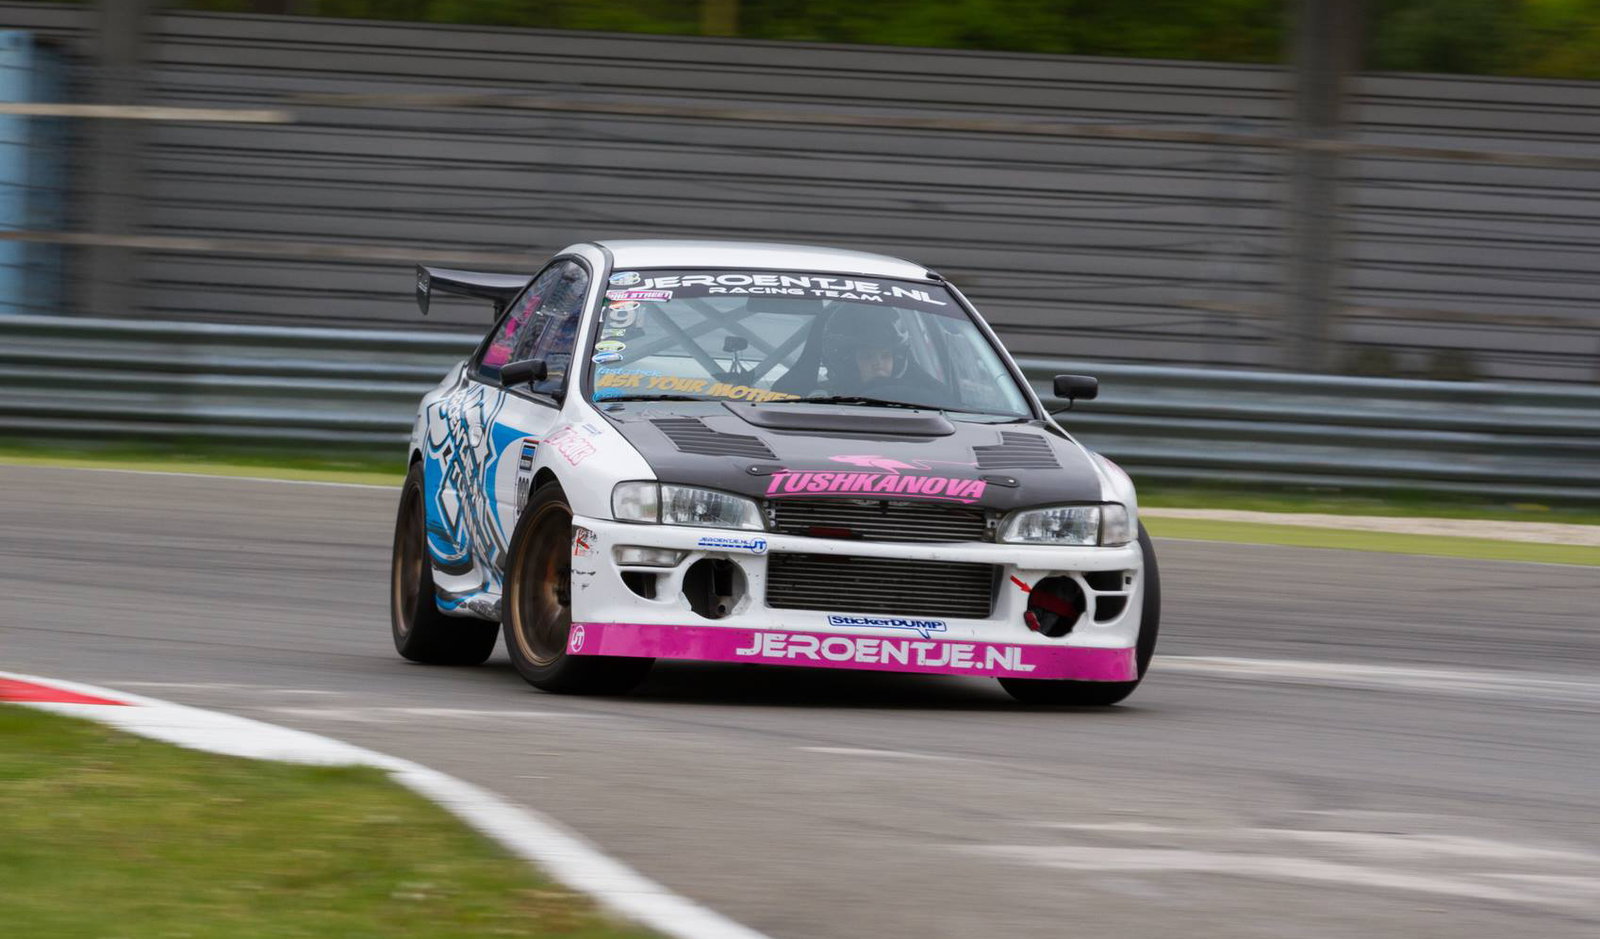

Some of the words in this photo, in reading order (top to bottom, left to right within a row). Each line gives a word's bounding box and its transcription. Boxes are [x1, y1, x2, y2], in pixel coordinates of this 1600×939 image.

[628, 274, 946, 305] JEROENTJE.NL
[708, 286, 797, 296] RACING
[802, 287, 883, 302] TEAM
[597, 374, 643, 388] ASK
[646, 376, 706, 393] YOUR
[765, 472, 987, 498] TUSHKANOVA
[831, 615, 943, 629] StickerDUMP
[735, 632, 1036, 673] JEROENTJE.NL
